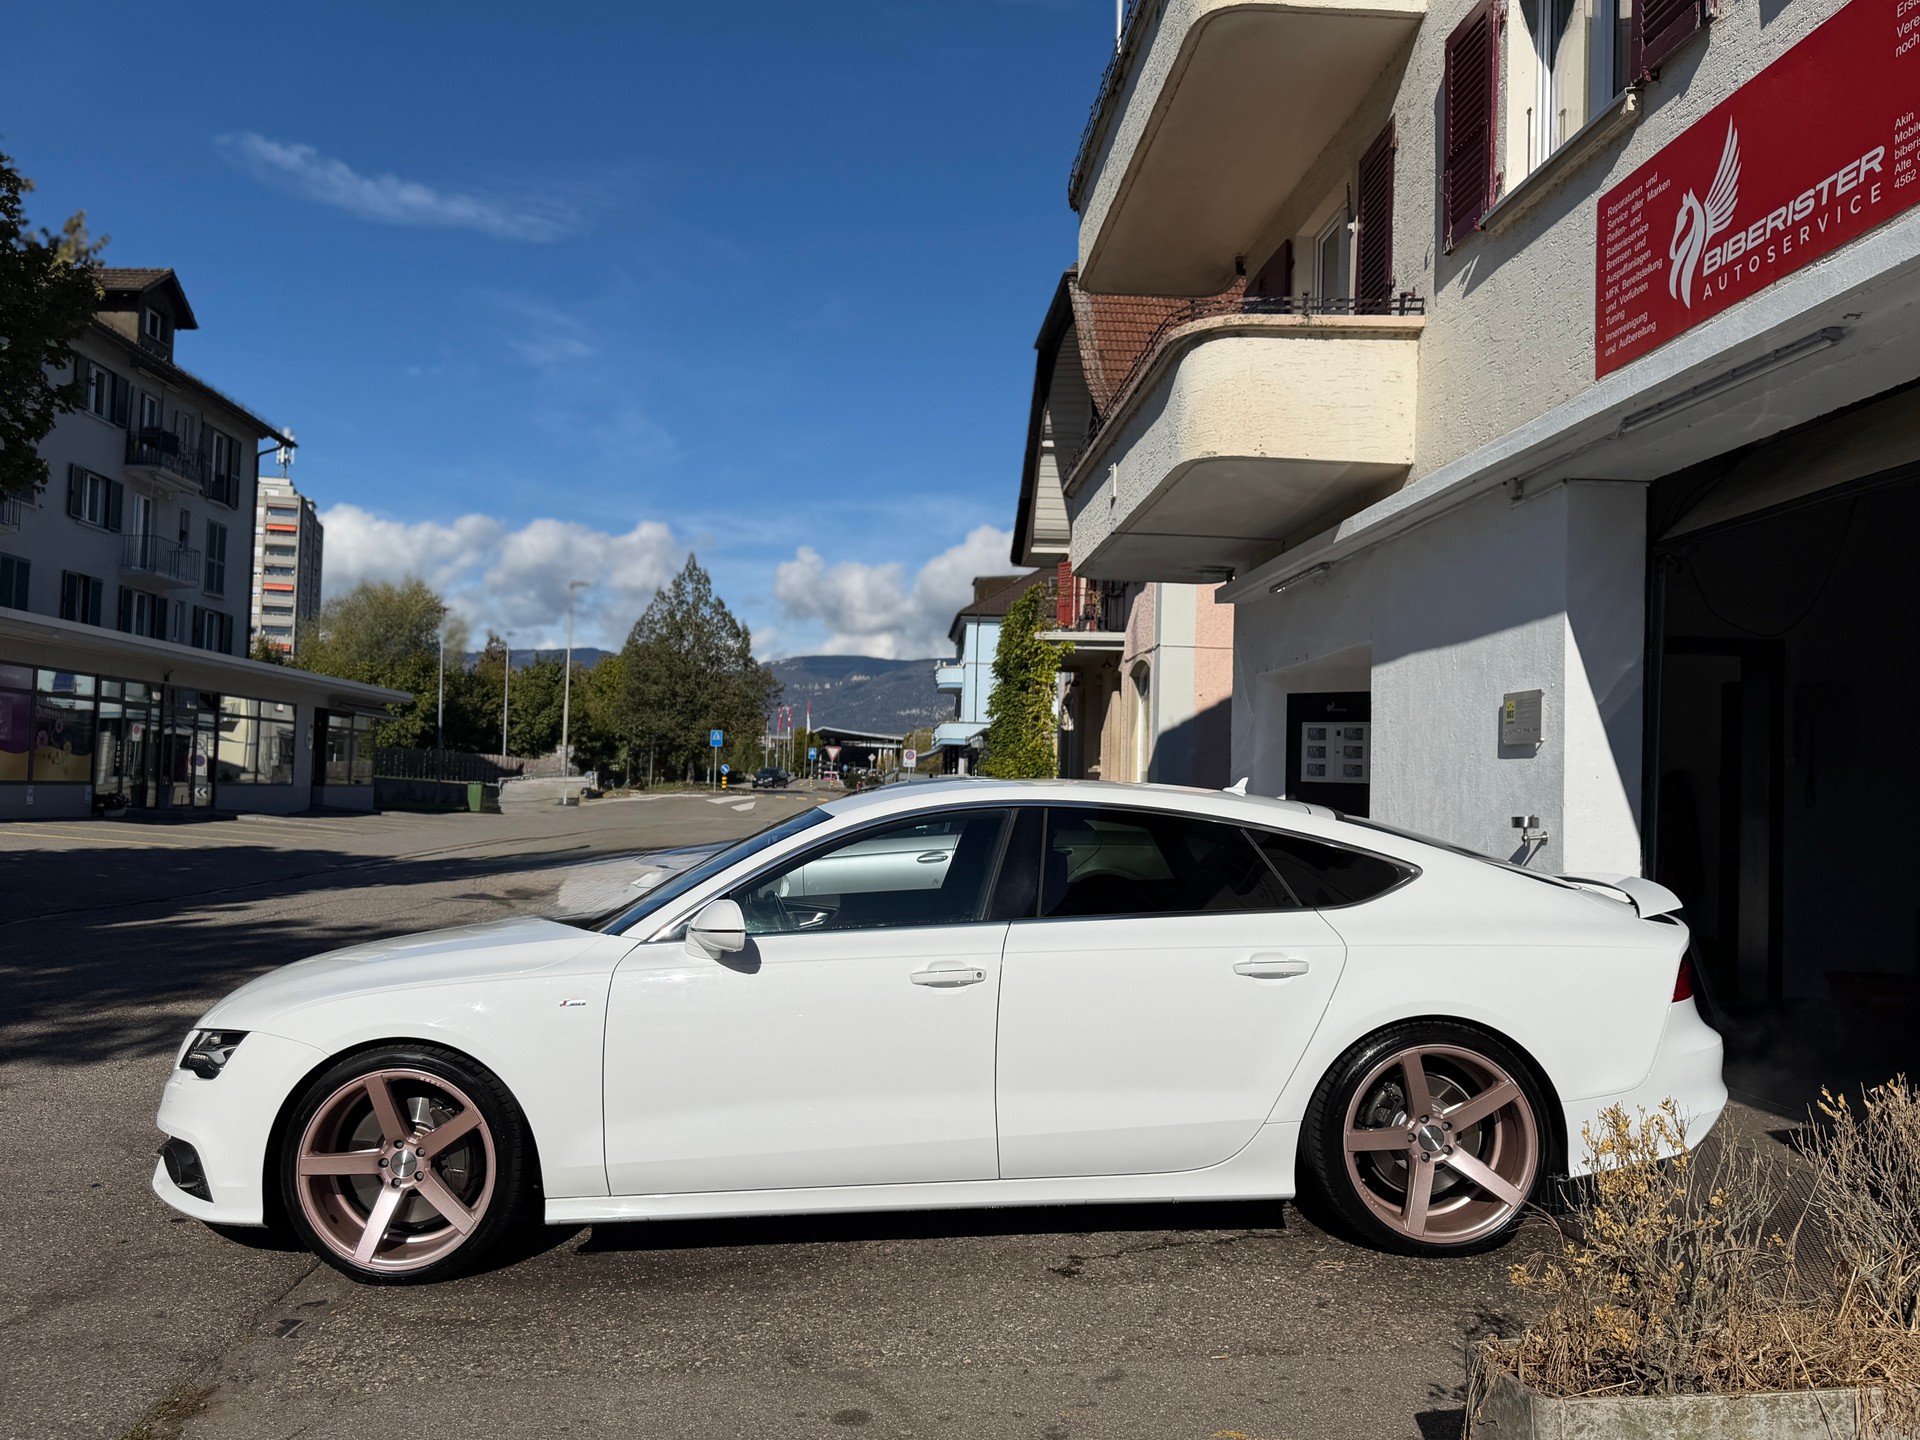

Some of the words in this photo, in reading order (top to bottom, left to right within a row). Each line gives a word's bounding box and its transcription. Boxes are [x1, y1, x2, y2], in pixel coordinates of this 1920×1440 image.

[1895, 32, 1920, 58] noch
[1894, 111, 1914, 131] Akin
[1894, 158, 1912, 176] Alte
[1894, 168, 1917, 189] 4562
[1607, 185, 1643, 217] Reparaturen
[1645, 171, 1658, 188] und
[1607, 210, 1629, 231] Service
[1631, 198, 1644, 214] aller
[1647, 179, 1671, 202] Marken
[1702, 145, 1885, 278] BIBERISTER
[1630, 211, 1642, 227] und
[1606, 223, 1649, 258] Batterieservice
[1606, 248, 1632, 271] Bremsen
[1634, 236, 1647, 252] und
[1703, 182, 1882, 301] AUTOSERVICE
[1606, 249, 1651, 286] Auspuffanlagen
[1606, 284, 1619, 301] MFK
[1622, 258, 1663, 290] Bereitstellung
[1606, 299, 1617, 314] und
[1620, 281, 1649, 305] Vorführen
[1606, 310, 1625, 326] Tuning
[1606, 311, 1648, 343] Innenreinigung
[1605, 342, 1617, 357] und
[1619, 321, 1657, 349] Aufbereitung
